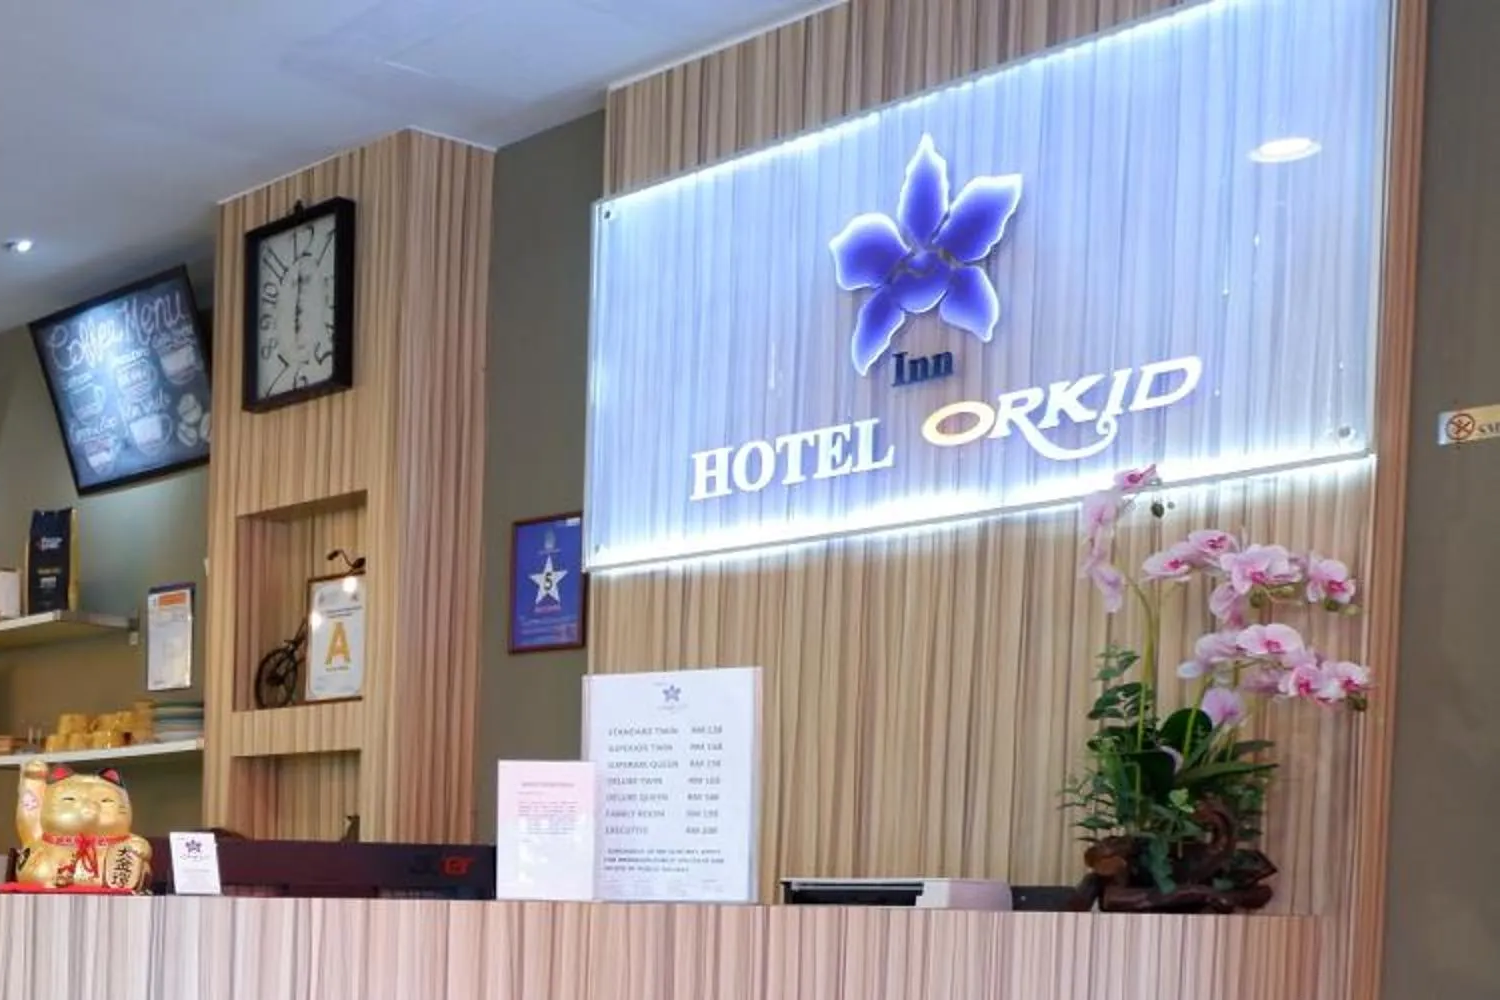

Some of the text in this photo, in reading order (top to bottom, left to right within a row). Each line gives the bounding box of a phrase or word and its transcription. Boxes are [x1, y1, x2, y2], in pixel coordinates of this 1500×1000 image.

[51, 318, 123, 371] Coffee
[116, 292, 186, 346] Menu
[891, 350, 954, 388] Inn
[689, 354, 1203, 502] HOTEL ORKID
[324, 621, 352, 667] A
